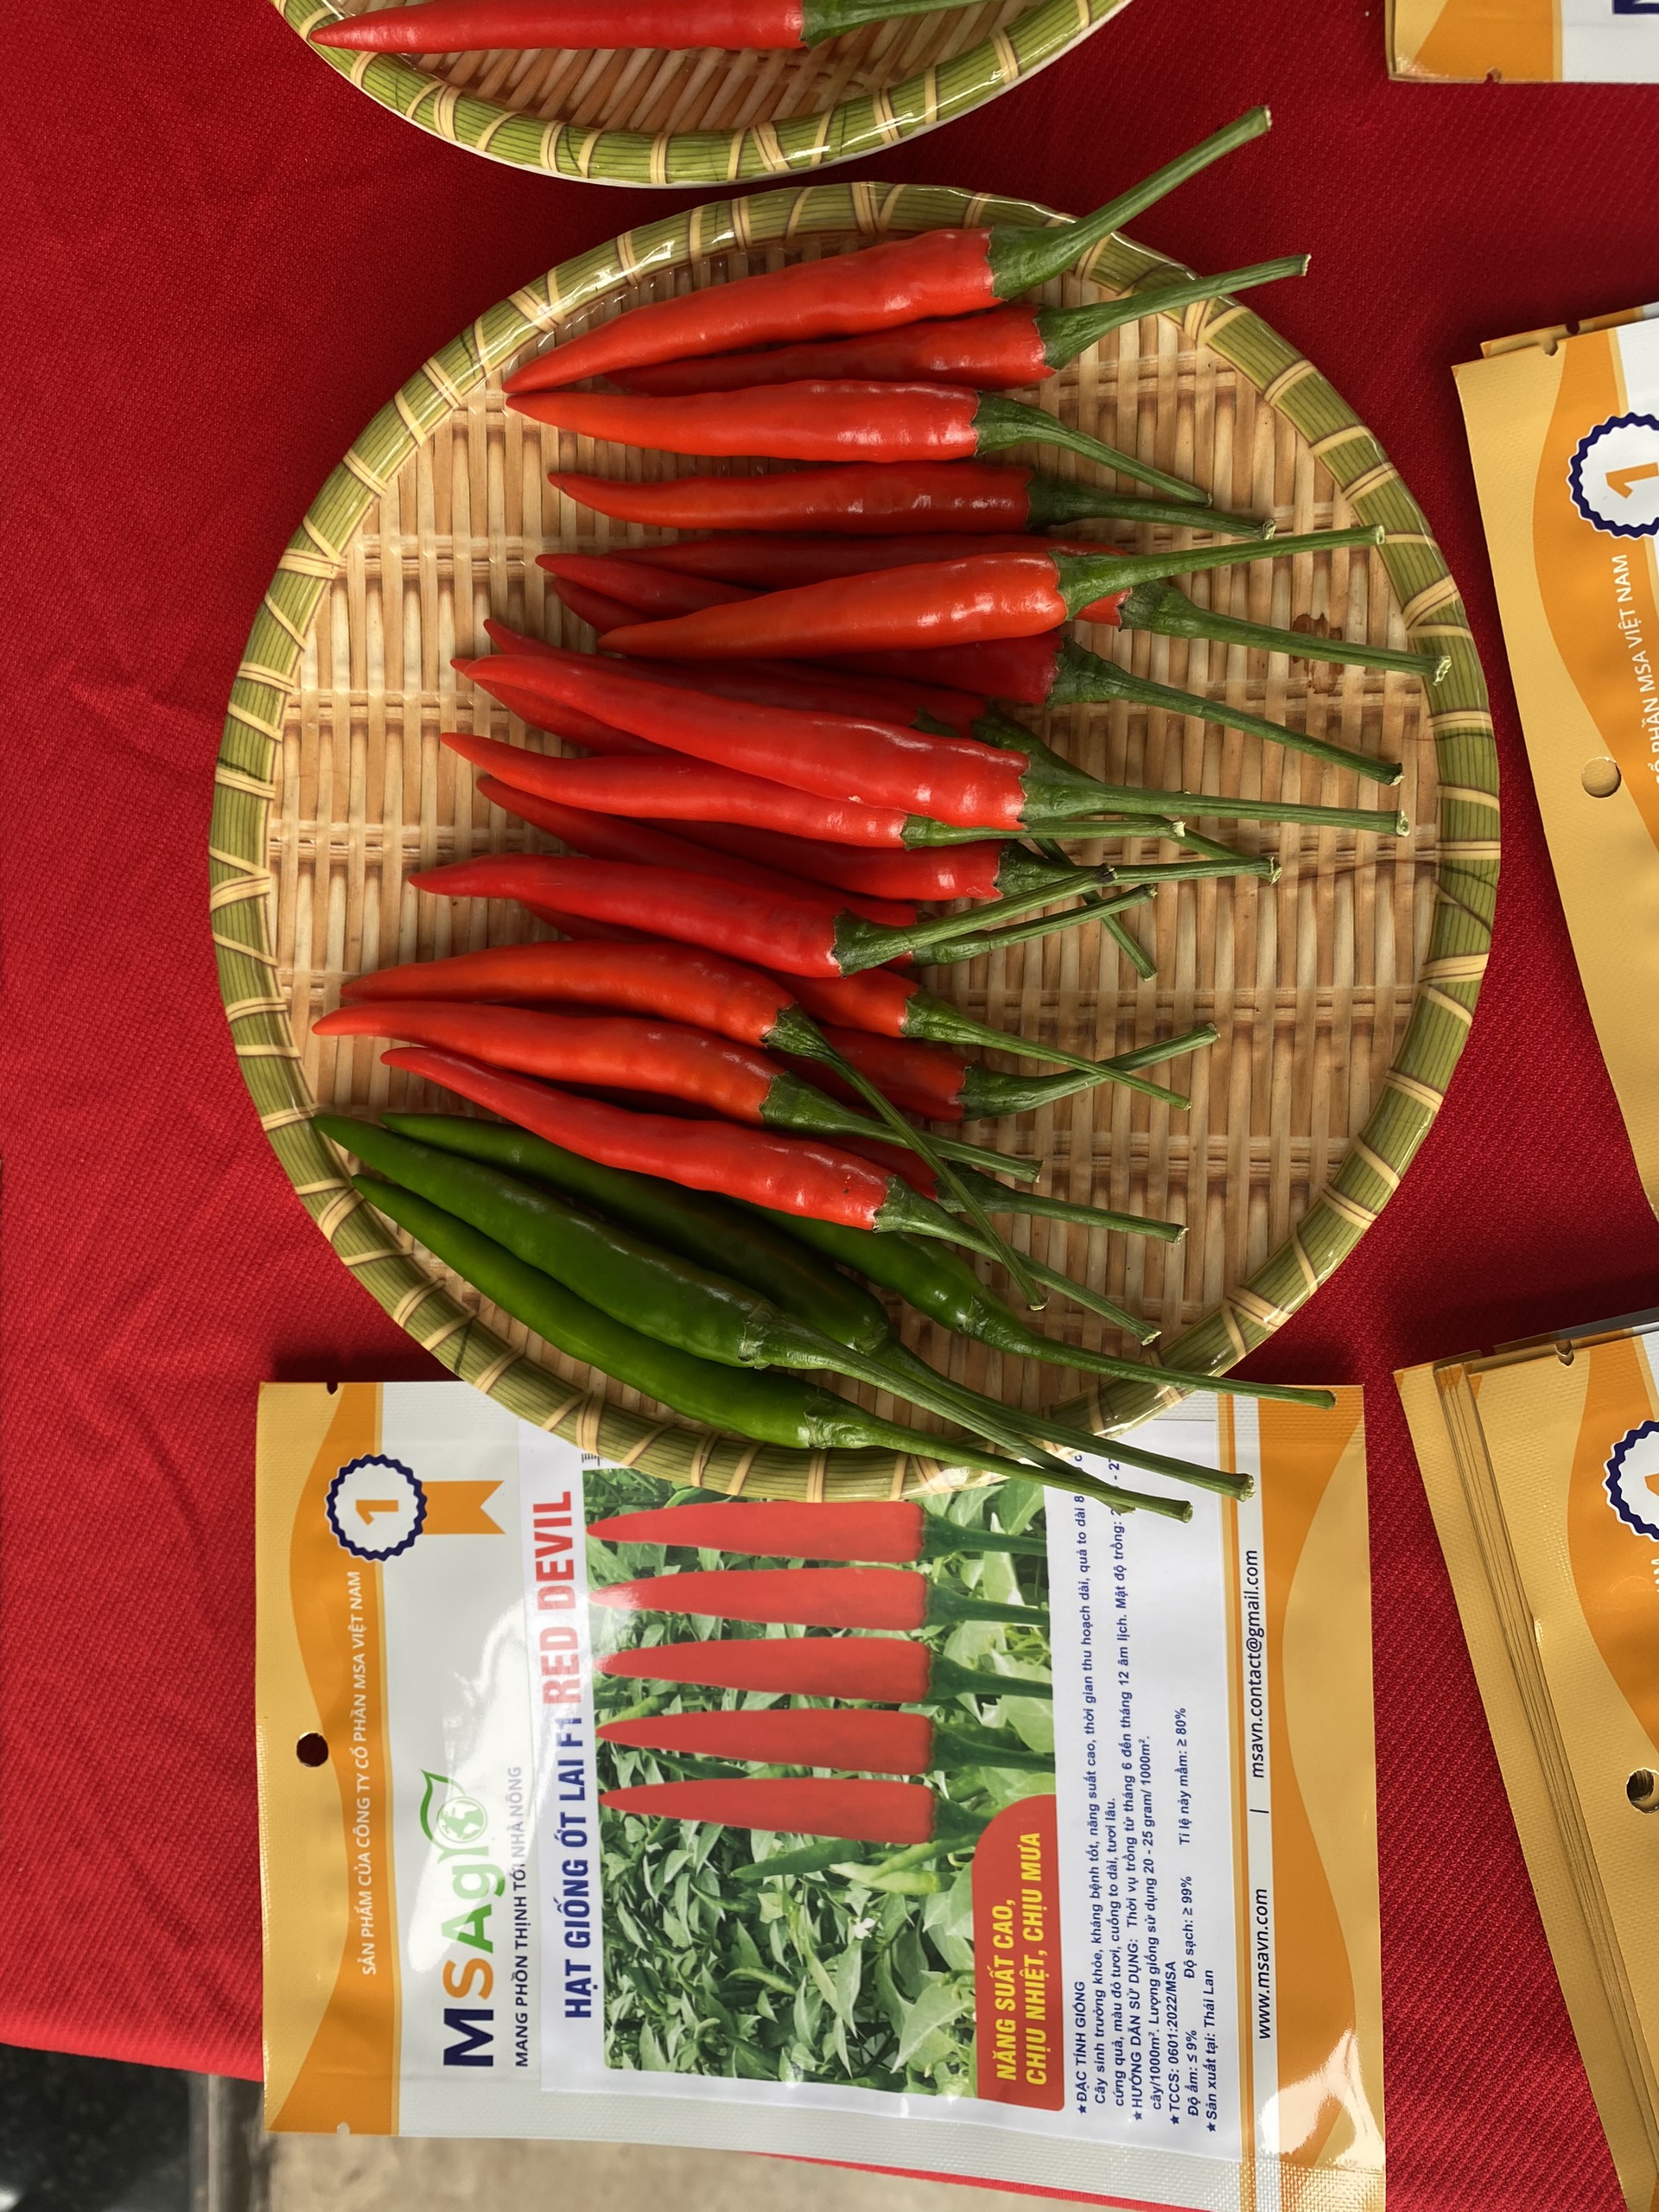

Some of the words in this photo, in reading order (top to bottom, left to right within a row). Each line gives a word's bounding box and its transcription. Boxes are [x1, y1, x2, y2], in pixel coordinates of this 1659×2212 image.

[1605, 462, 1659, 499] 1
[1611, 554, 1633, 603] NAM
[1618, 608, 1643, 648] VIỆT
[1631, 651, 1656, 693] MSA
[355, 1500, 399, 1526] 1
[1075, 1508, 1085, 1526] dài
[532, 1491, 575, 1611] DEVIL
[1077, 1532, 1087, 1544] to
[1110, 1522, 1125, 1560] trồng:
[1077, 1549, 1090, 1573] quả
[1114, 1566, 1126, 1581] độ
[347, 1571, 362, 1610] NAM
[1078, 1578, 1090, 1600] dài,
[1116, 1586, 1128, 1609] Mật
[349, 1614, 367, 1649] VIỆT
[1080, 1605, 1093, 1645] hoạch
[1116, 1614, 1130, 1641] lịch.
[353, 1655, 366, 1688] MSA
[539, 1626, 581, 1704] RED
[1082, 1650, 1092, 1671] thu
[1117, 1647, 1128, 1666] âm
[1244, 1550, 1265, 1778] msavn.contact@gmail.com
[1083, 1676, 1096, 1704] gian
[1118, 1671, 1128, 1685] 12
[349, 1694, 366, 1741] PHẦN
[1084, 1708, 1094, 1734] thời
[1118, 1692, 1132, 1728] tháng
[1175, 1707, 1186, 1735] 80%
[555, 1717, 582, 1747] F1
[1118, 1733, 1132, 1758] đến
[349, 1747, 369, 1769] CỔ
[1085, 1740, 1096, 1766] cao,
[1174, 1751, 1188, 1787] mầm:
[356, 1773, 370, 1792] TY
[505, 1766, 522, 1817] NÔNG
[557, 1759, 585, 1802] LAI
[1084, 1771, 1097, 1799] suất
[1122, 1775, 1135, 1812] tháng
[353, 1797, 370, 1847] CÔNG
[1087, 1804, 1099, 1835] năng
[1104, 1798, 1116, 1821] lâu.
[1123, 1816, 1134, 1832] từ
[1141, 1789, 1154, 1827] gram/
[1179, 1818, 1192, 1829] lệ
[506, 1821, 525, 1858] NHÀ
[554, 1812, 588, 1847] ỚT
[1105, 1825, 1116, 1853] tươi
[1142, 1831, 1153, 1846] 25
[1017, 1833, 1042, 1881] MƯA
[1085, 1841, 1099, 1862] tốt,
[1122, 1837, 1137, 1872] trồng
[1143, 1858, 1154, 1873] 20
[354, 1853, 372, 1886] CỦA
[508, 1864, 526, 1891] TỚI
[1089, 1866, 1103, 1899] bệnh
[1106, 1857, 1119, 1880] dài,
[1128, 1877, 1139, 1892] vụ
[553, 1859, 589, 1948] GIỐNG
[1108, 1884, 1118, 1897] to
[1144, 1878, 1158, 1911] dụng
[1180, 1876, 1192, 1904] 99%
[353, 1891, 374, 1937] PHẨM
[513, 1896, 531, 1949] THỊNH
[992, 1899, 1016, 1949] CAO,
[1021, 1889, 1047, 1942] CHỊU
[1090, 1904, 1103, 1944] kháng
[1106, 1901, 1122, 1942] cuống
[1126, 1897, 1137, 1927] Thời
[1144, 1915, 1156, 1933] sử
[1182, 1920, 1195, 1956] sạch:
[357, 1943, 376, 1975] SẢN
[1090, 1949, 1103, 1984] khỏe,
[1109, 1946, 1122, 1977] tươi,
[1128, 1939, 1141, 1984] DỤNG:
[1144, 1936, 1160, 1974] giống
[1184, 1960, 1195, 1979] Độ
[1255, 1889, 1270, 2039] www.msavn.com
[511, 1956, 528, 2006] PHỒN
[563, 1959, 598, 2018] HẠT
[987, 1955, 1015, 2012] SUẤT
[1019, 1949, 1050, 2020] NHIỆT,
[1110, 1982, 1122, 1998] đỏ
[1204, 1970, 1214, 1994] Lan
[1091, 1989, 1106, 2037] trưởng
[1126, 1988, 1141, 2010] SỬ
[1147, 1979, 1160, 2024] Lượng
[1165, 1961, 1179, 2064] 0601:2022/MSA
[1203, 1999, 1215, 2028] Thái
[1111, 2003, 1123, 2032] màu
[515, 2012, 528, 2067] MANG
[992, 2018, 1016, 2081] NĂNG
[1073, 2032, 1087, 2066] TÍNH
[1111, 2037, 1125, 2066] quả,
[1185, 2031, 1197, 2050] 9%
[1205, 2033, 1218, 2054] tại:
[1025, 2028, 1051, 2085] CHỊU
[1094, 2043, 1104, 2073] sinh
[1113, 2070, 1125, 2107] cứng
[1128, 2051, 1142, 2108] HƯỚNG
[1185, 2067, 1198, 2093] ẩm:
[1203, 2058, 1217, 2089] xuất
[1094, 2078, 1108, 2104] Cây
[1168, 2069, 1180, 2112] TCCS:
[1187, 2096, 1200, 2116] Độ
[1206, 2094, 1217, 2120] Sản
